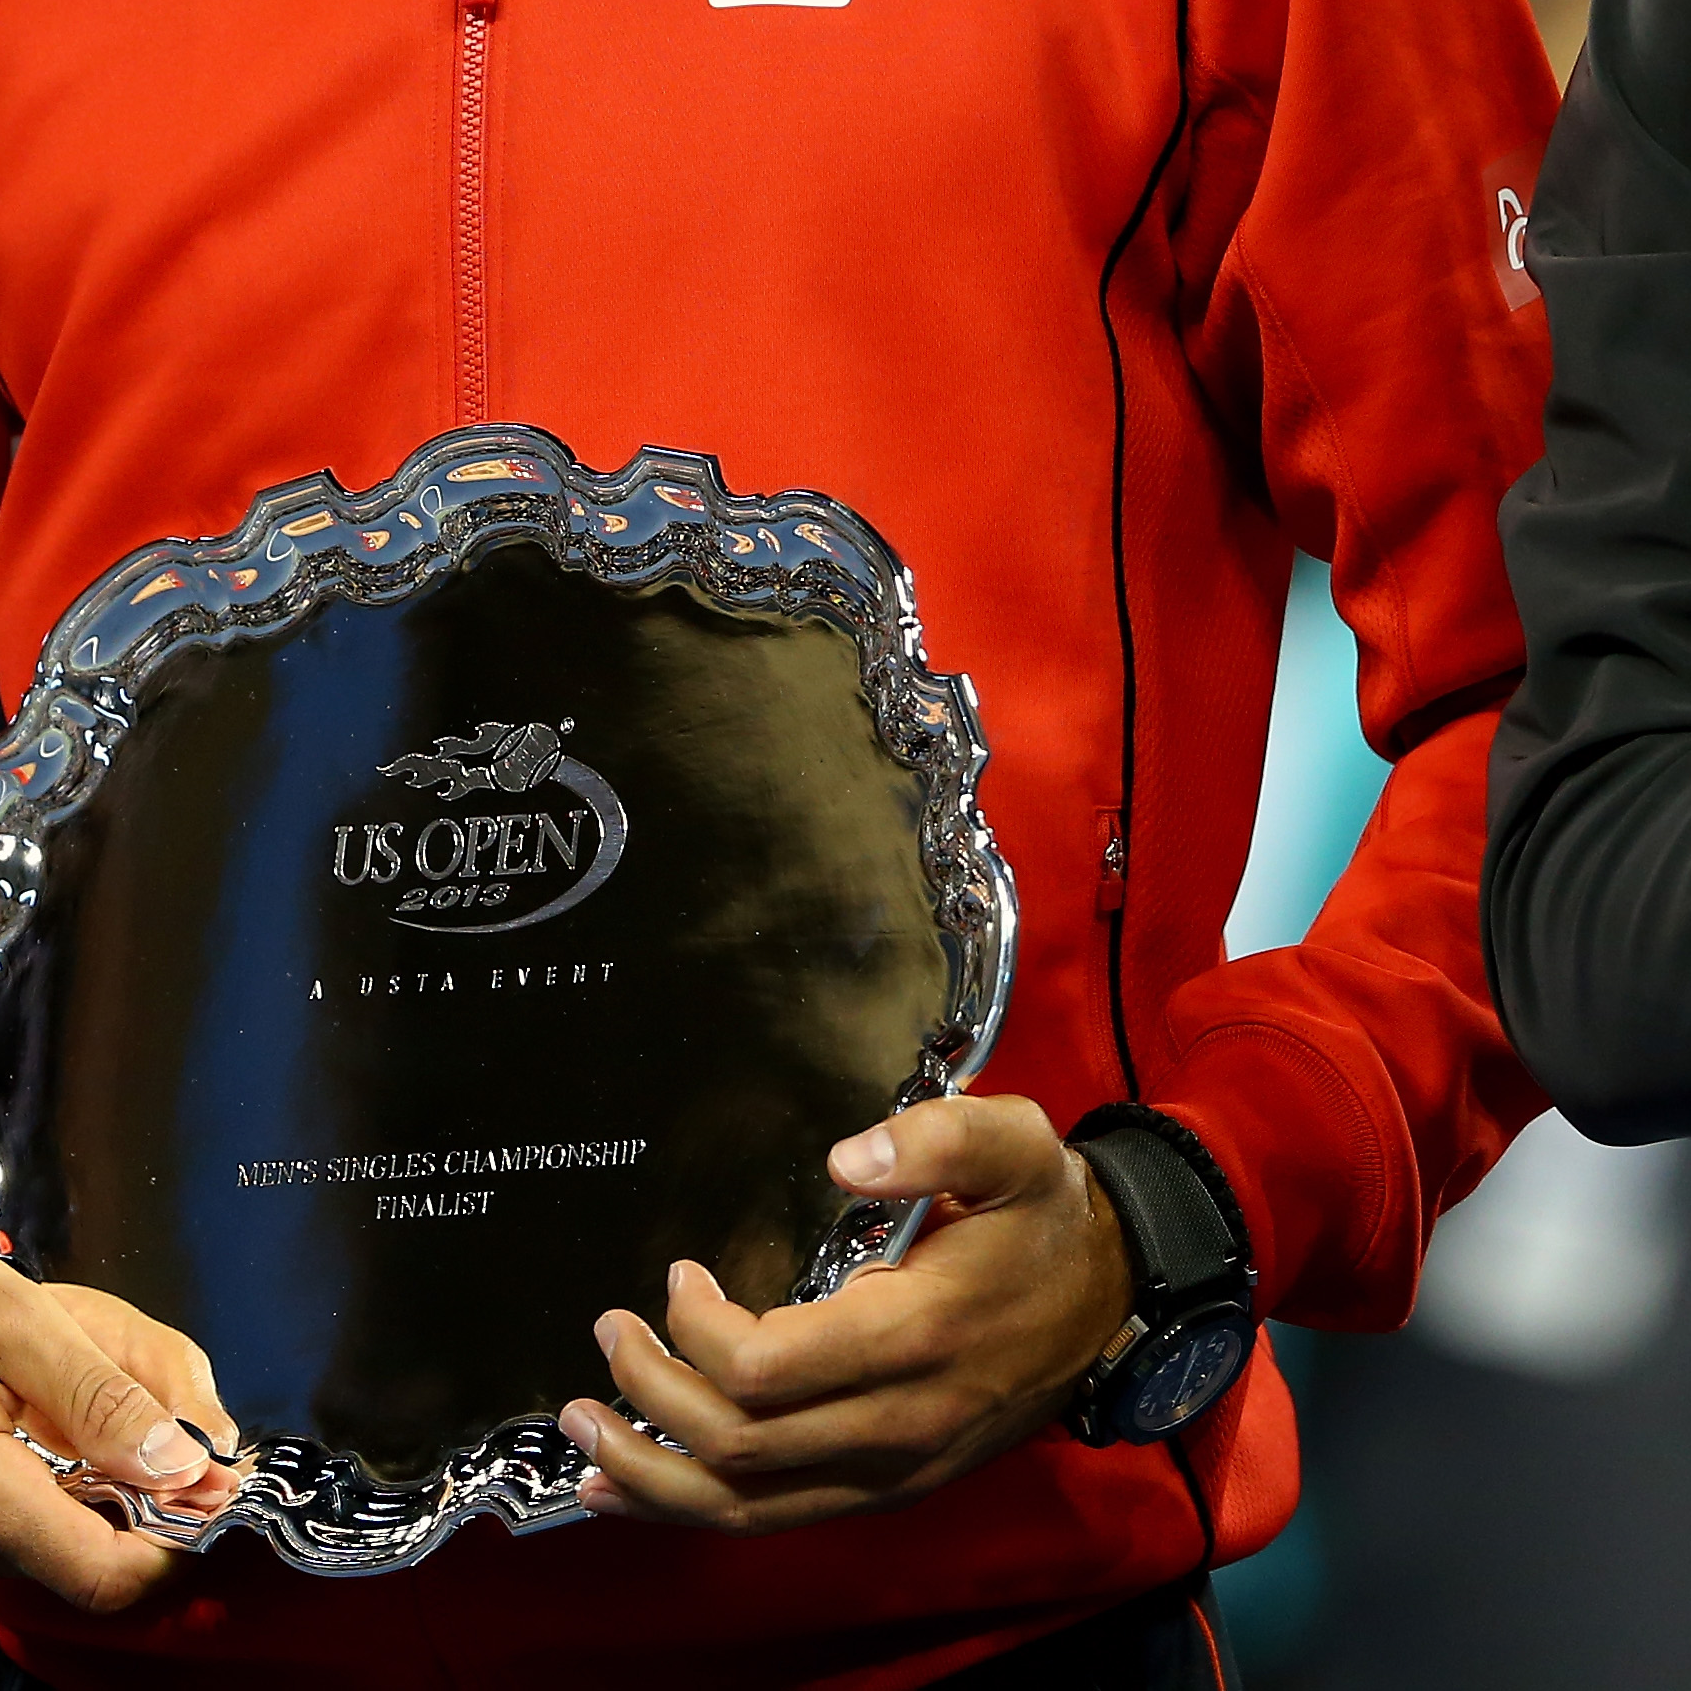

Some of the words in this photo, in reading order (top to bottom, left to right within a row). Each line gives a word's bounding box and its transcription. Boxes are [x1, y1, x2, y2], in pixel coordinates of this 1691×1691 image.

[333, 821, 404, 886] US
[415, 809, 588, 881] OPEN
[395, 882, 510, 912] 2013
[309, 979, 324, 1000] A
[360, 971, 454, 997] USTA
[491, 962, 614, 989] EVENT
[235, 1158, 319, 1188] MEN'S
[326, 1151, 437, 1184] SINGLES
[443, 1138, 648, 1176] CHAMPIONSHIP
[374, 1190, 497, 1221] FINALIST
